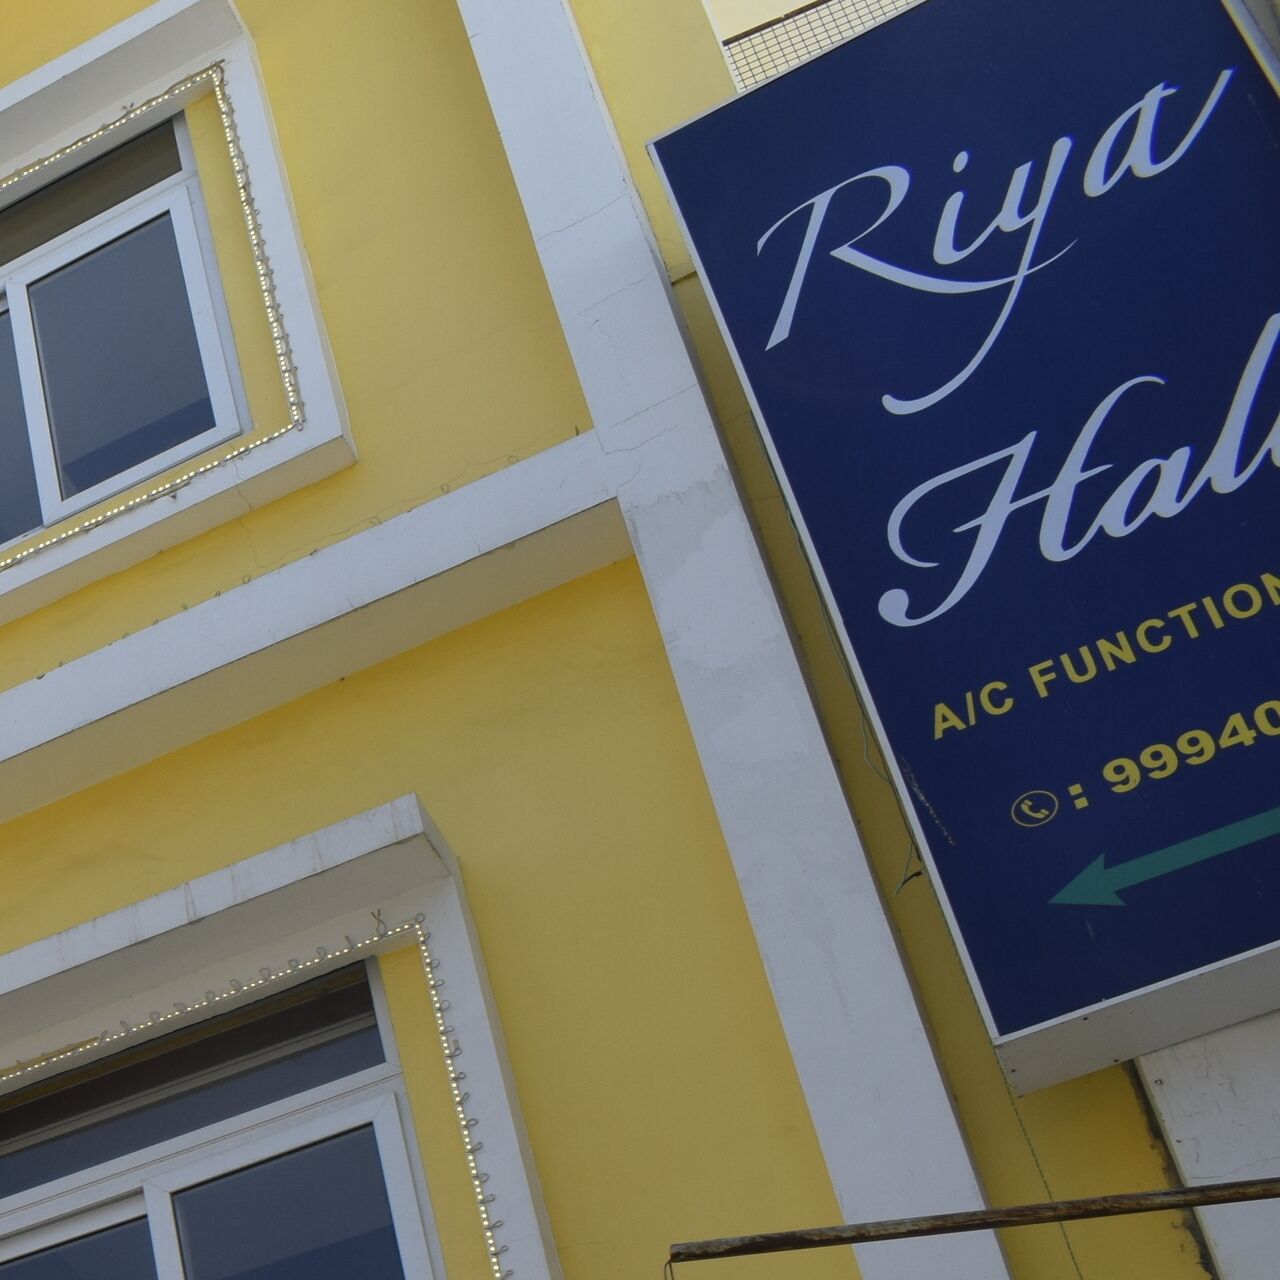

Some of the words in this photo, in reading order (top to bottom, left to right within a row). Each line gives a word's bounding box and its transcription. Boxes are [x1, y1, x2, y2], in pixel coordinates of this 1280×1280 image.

[756, 67, 1234, 415] Riya
[877, 312, 1280, 627] Hal
[931, 679, 1015, 740] A/C
